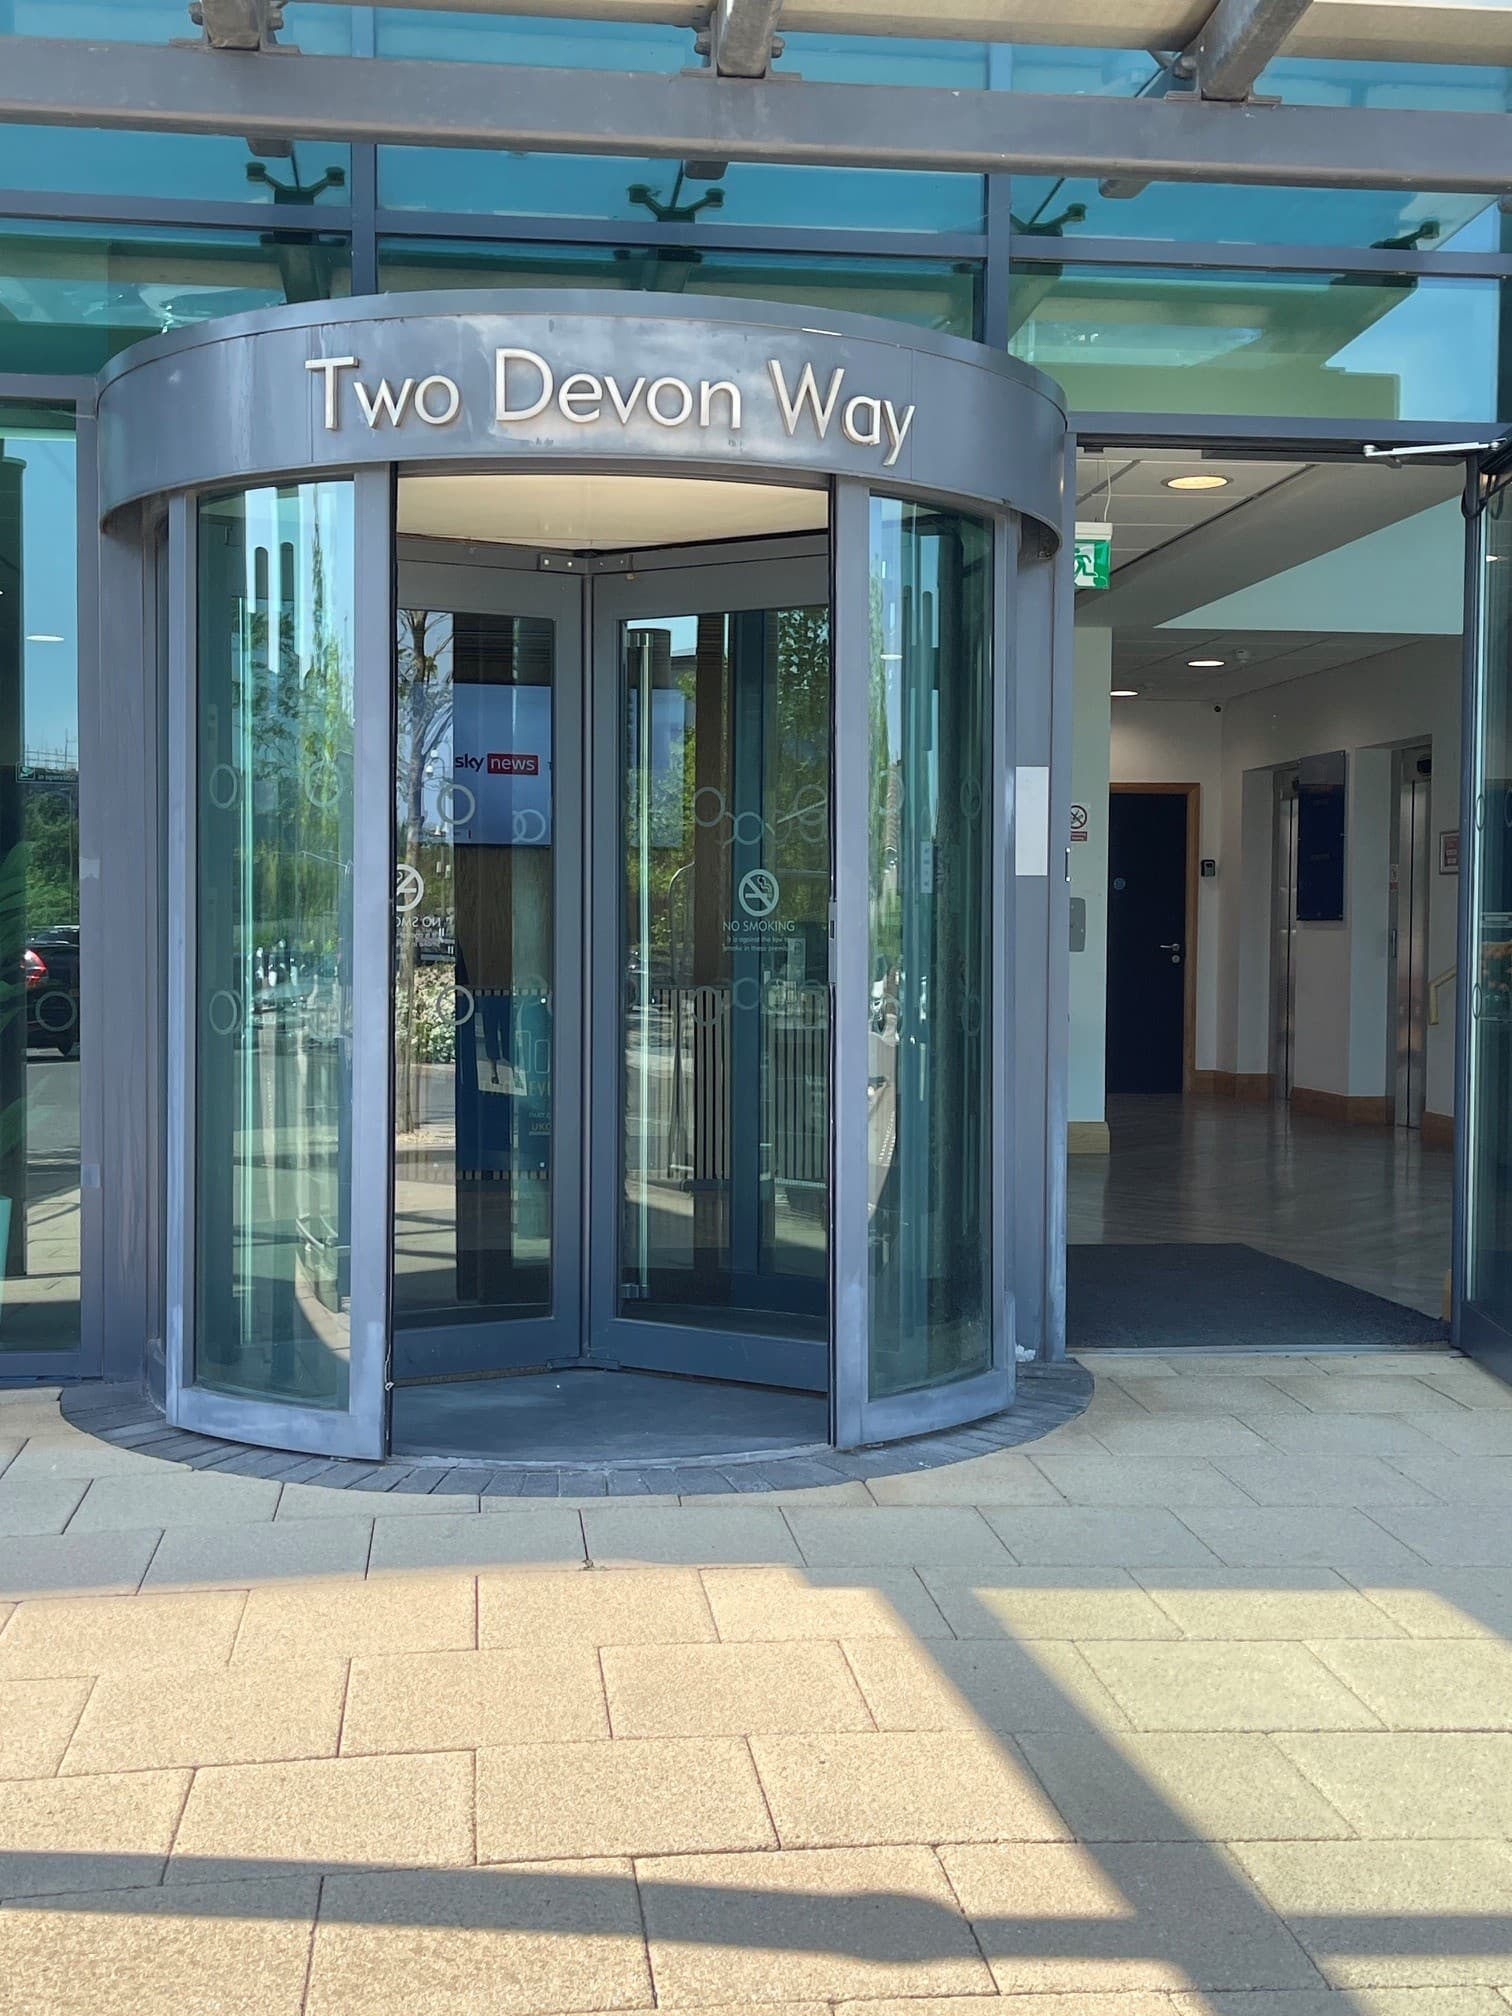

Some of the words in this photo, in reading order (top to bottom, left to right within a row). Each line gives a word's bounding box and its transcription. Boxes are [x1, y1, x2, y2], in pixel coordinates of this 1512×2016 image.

[305, 356, 460, 430] Two
[496, 348, 742, 429] Devon
[768, 359, 916, 466] Way
[455, 753, 485, 772] sky
[491, 757, 535, 771] news
[723, 921, 740, 932] NO
[743, 920, 795, 932] SMOKING
